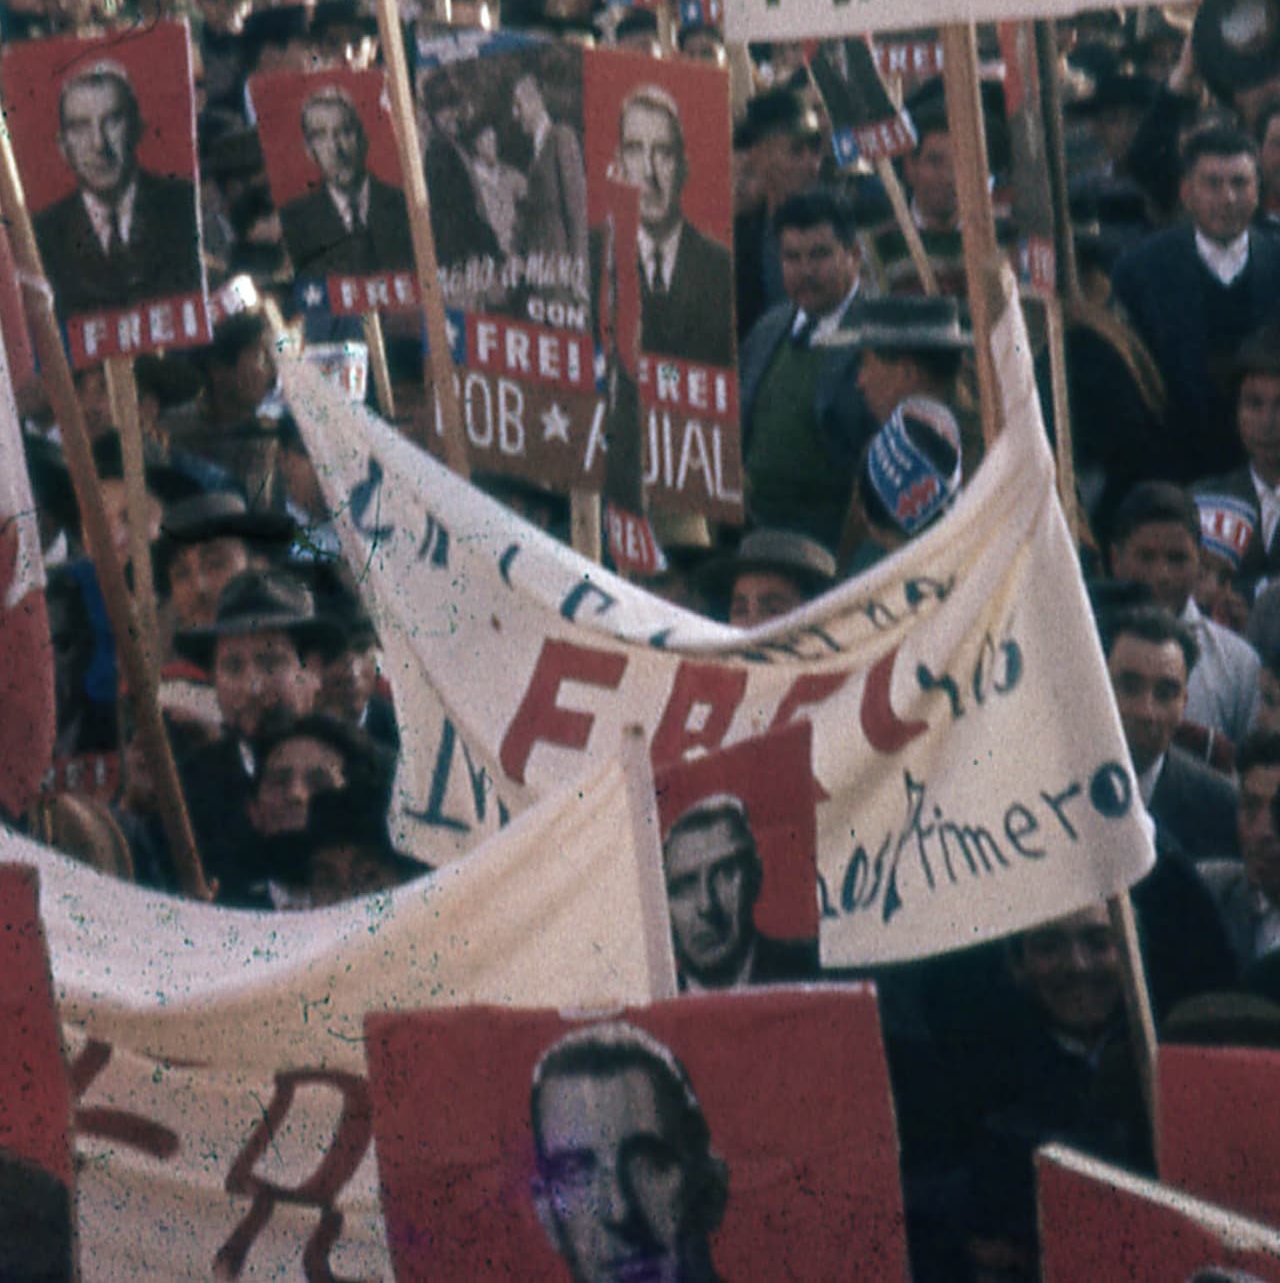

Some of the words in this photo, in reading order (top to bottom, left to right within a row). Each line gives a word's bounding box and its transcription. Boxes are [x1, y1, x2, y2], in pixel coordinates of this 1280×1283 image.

[339, 277, 416, 310] FRE
[81, 299, 198, 355] FREI
[476, 320, 582, 383] FREI
